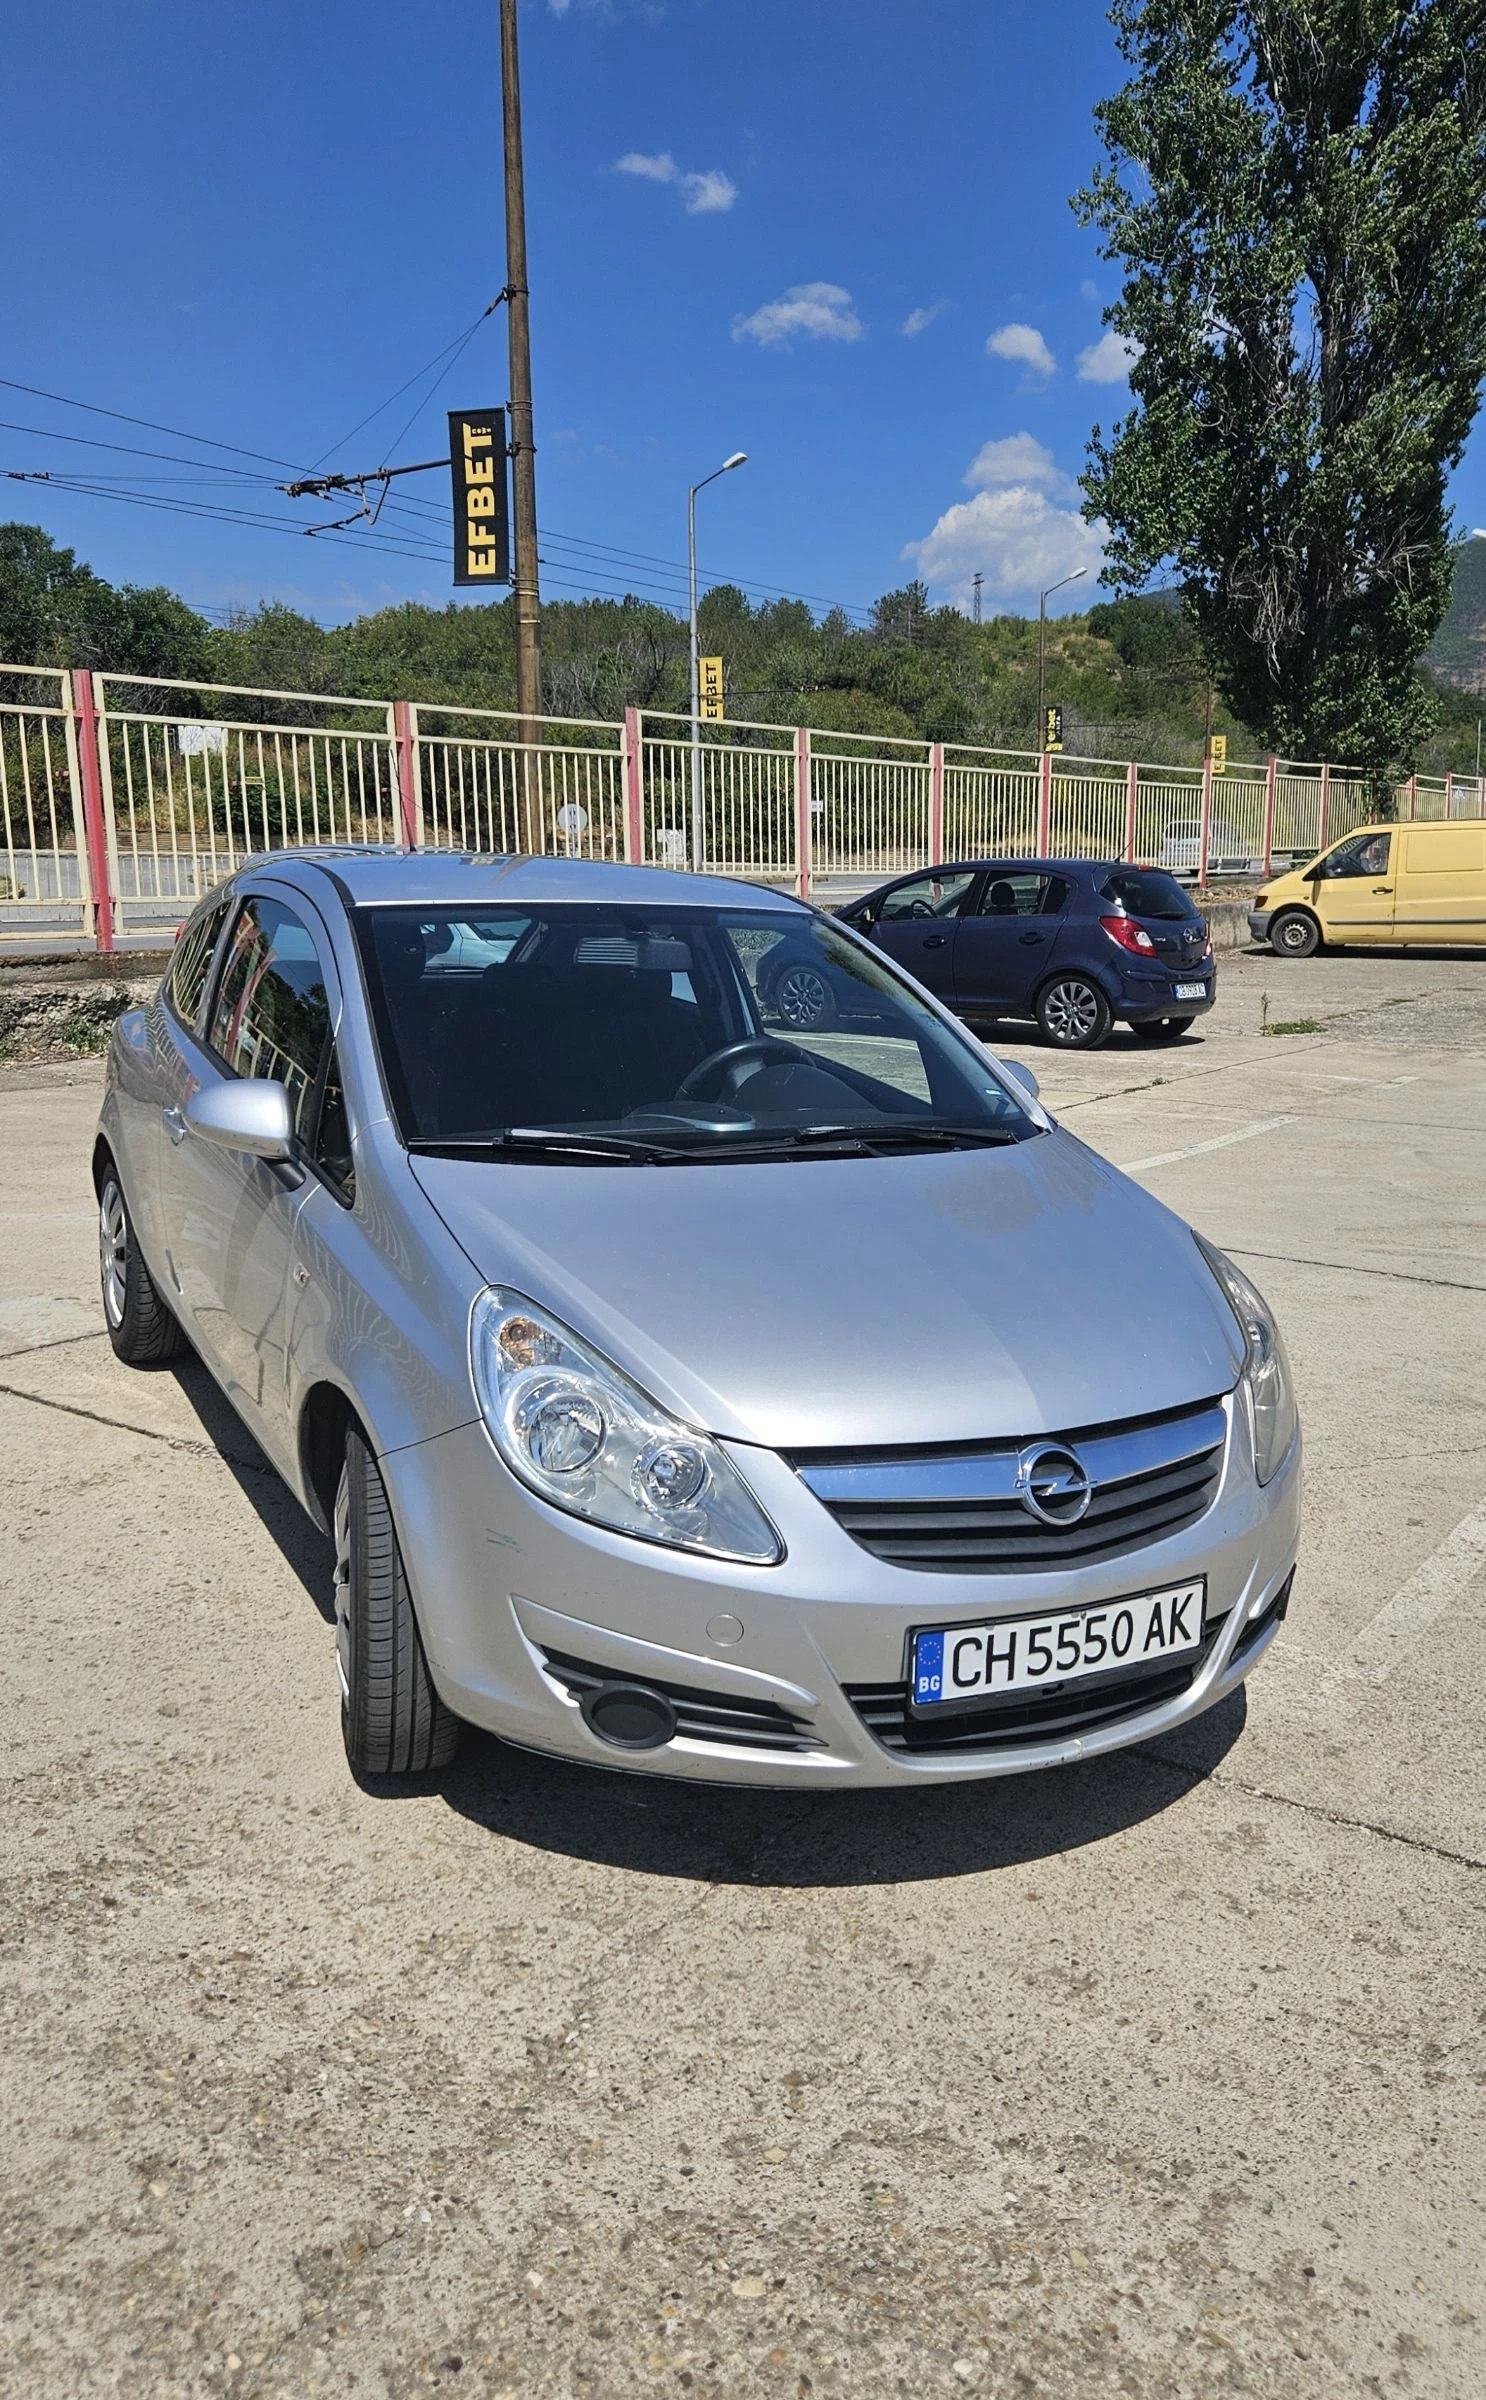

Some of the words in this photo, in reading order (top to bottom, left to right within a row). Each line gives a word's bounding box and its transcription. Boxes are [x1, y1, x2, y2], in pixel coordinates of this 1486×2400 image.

[463, 422, 496, 575] EFBET
[706, 662, 717, 718] EFBET
[918, 1674, 941, 1694] BG
